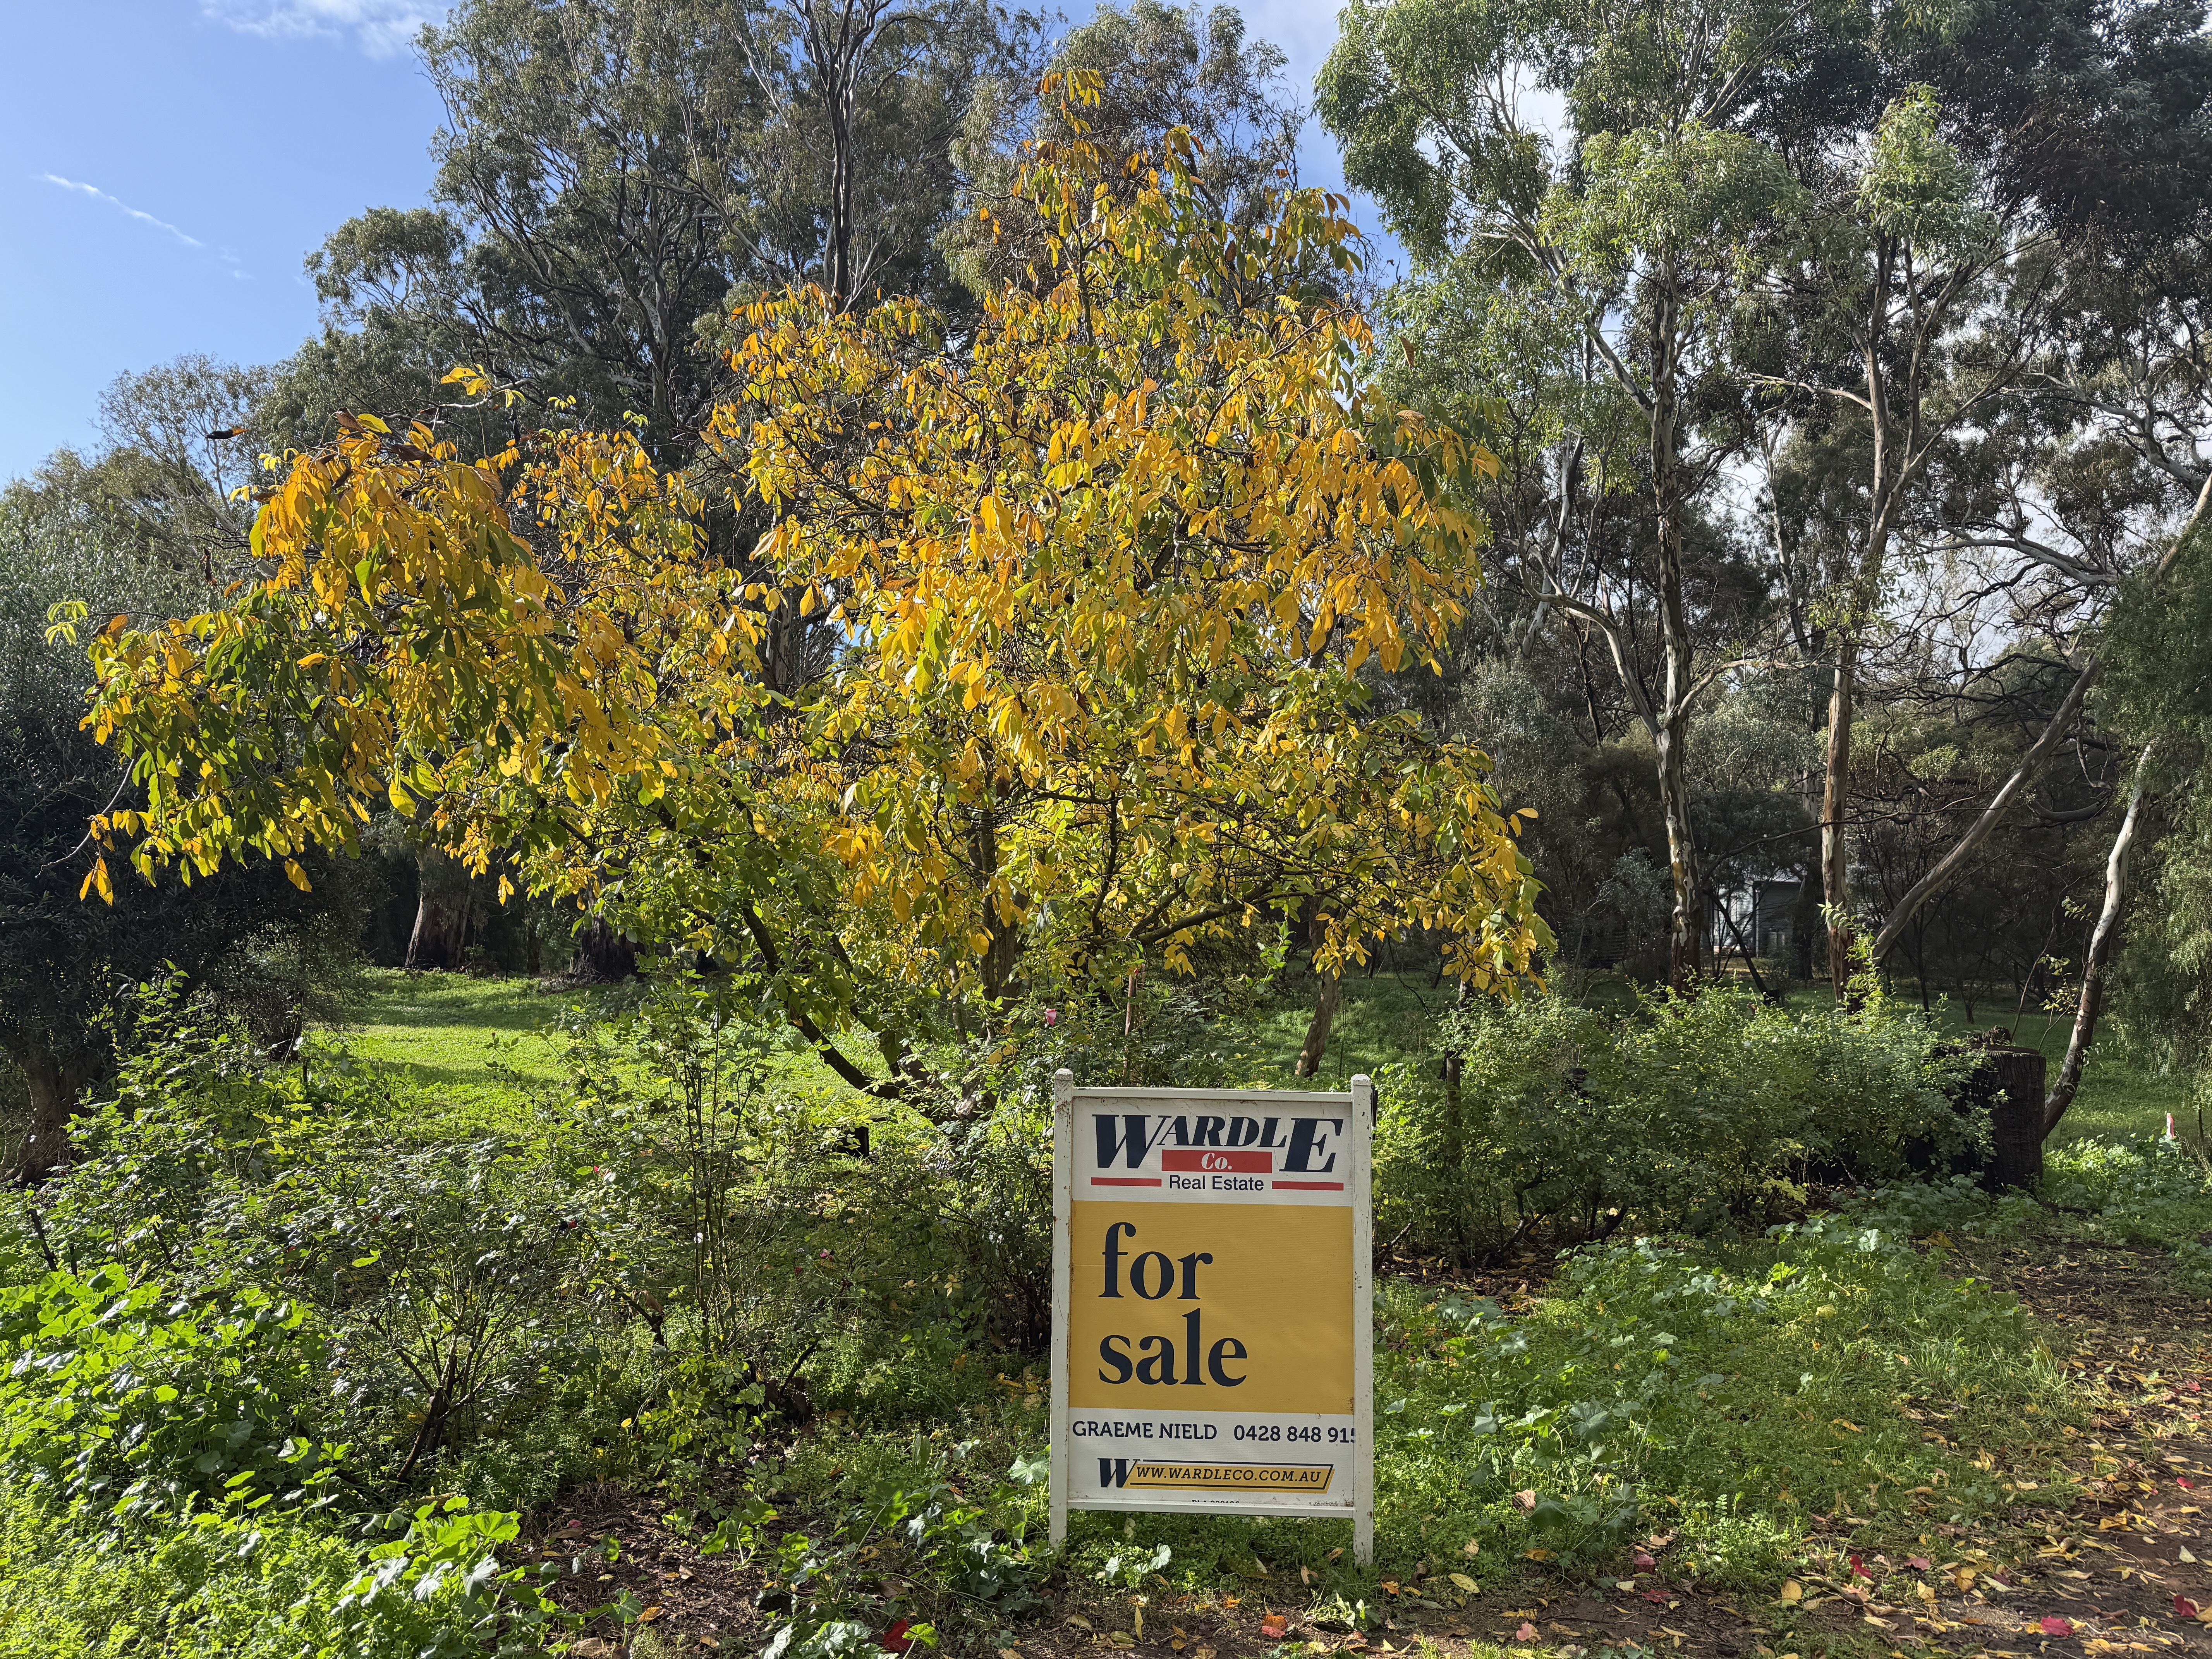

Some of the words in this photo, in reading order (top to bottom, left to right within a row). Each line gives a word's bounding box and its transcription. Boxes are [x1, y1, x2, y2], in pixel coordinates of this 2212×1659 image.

[1092, 1114, 1343, 1173] WARDLE
[1201, 1152, 1232, 1170] Co.
[1170, 1175, 1205, 1189] Real
[1212, 1176, 1264, 1191] Estate
[1098, 1222, 1213, 1300] for
[1099, 1307, 1247, 1387] sale
[1072, 1420, 1153, 1438] GRAEME
[1159, 1423, 1217, 1439] NIELD
[1234, 1425, 1281, 1441] 0428
[1287, 1426, 1321, 1442] 848
